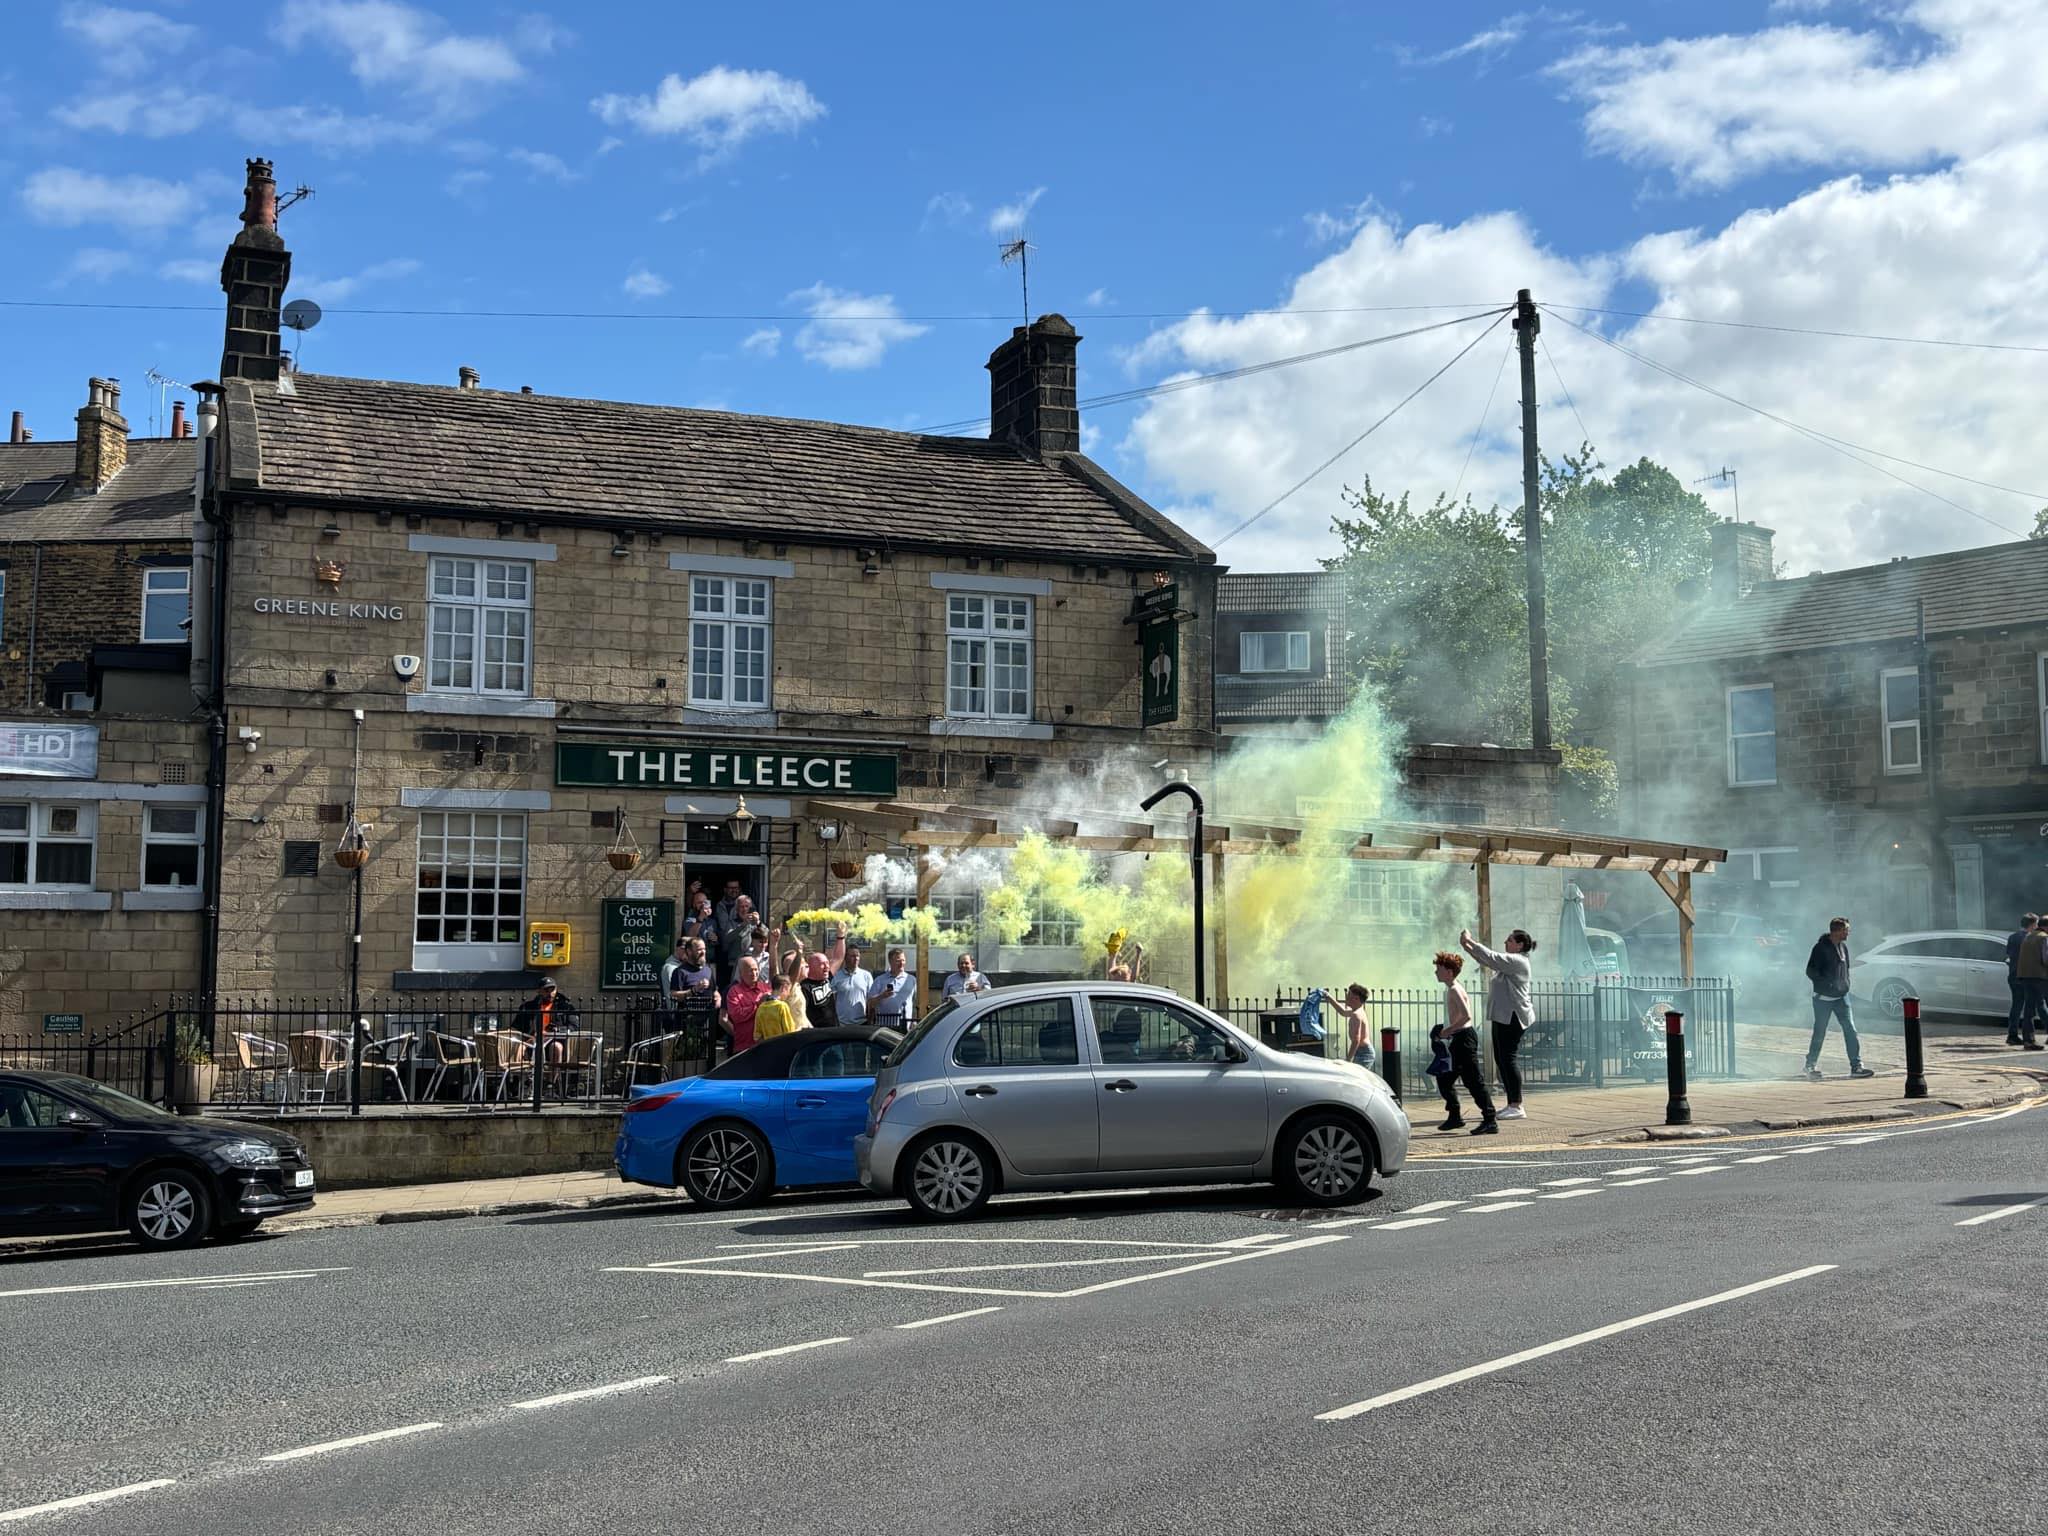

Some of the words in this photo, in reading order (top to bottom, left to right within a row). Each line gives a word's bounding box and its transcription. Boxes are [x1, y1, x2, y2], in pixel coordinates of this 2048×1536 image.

[254, 598, 339, 616] GREENE
[350, 604, 403, 620] KING
[23, 734, 65, 754] HD
[608, 750, 692, 783] THE
[710, 754, 853, 789] FLEECE
[619, 904, 657, 917] Great
[623, 915, 653, 927] food
[621, 932, 654, 944] Cask
[624, 943, 650, 955] ales
[622, 960, 652, 972] Live
[615, 971, 658, 984] sports
